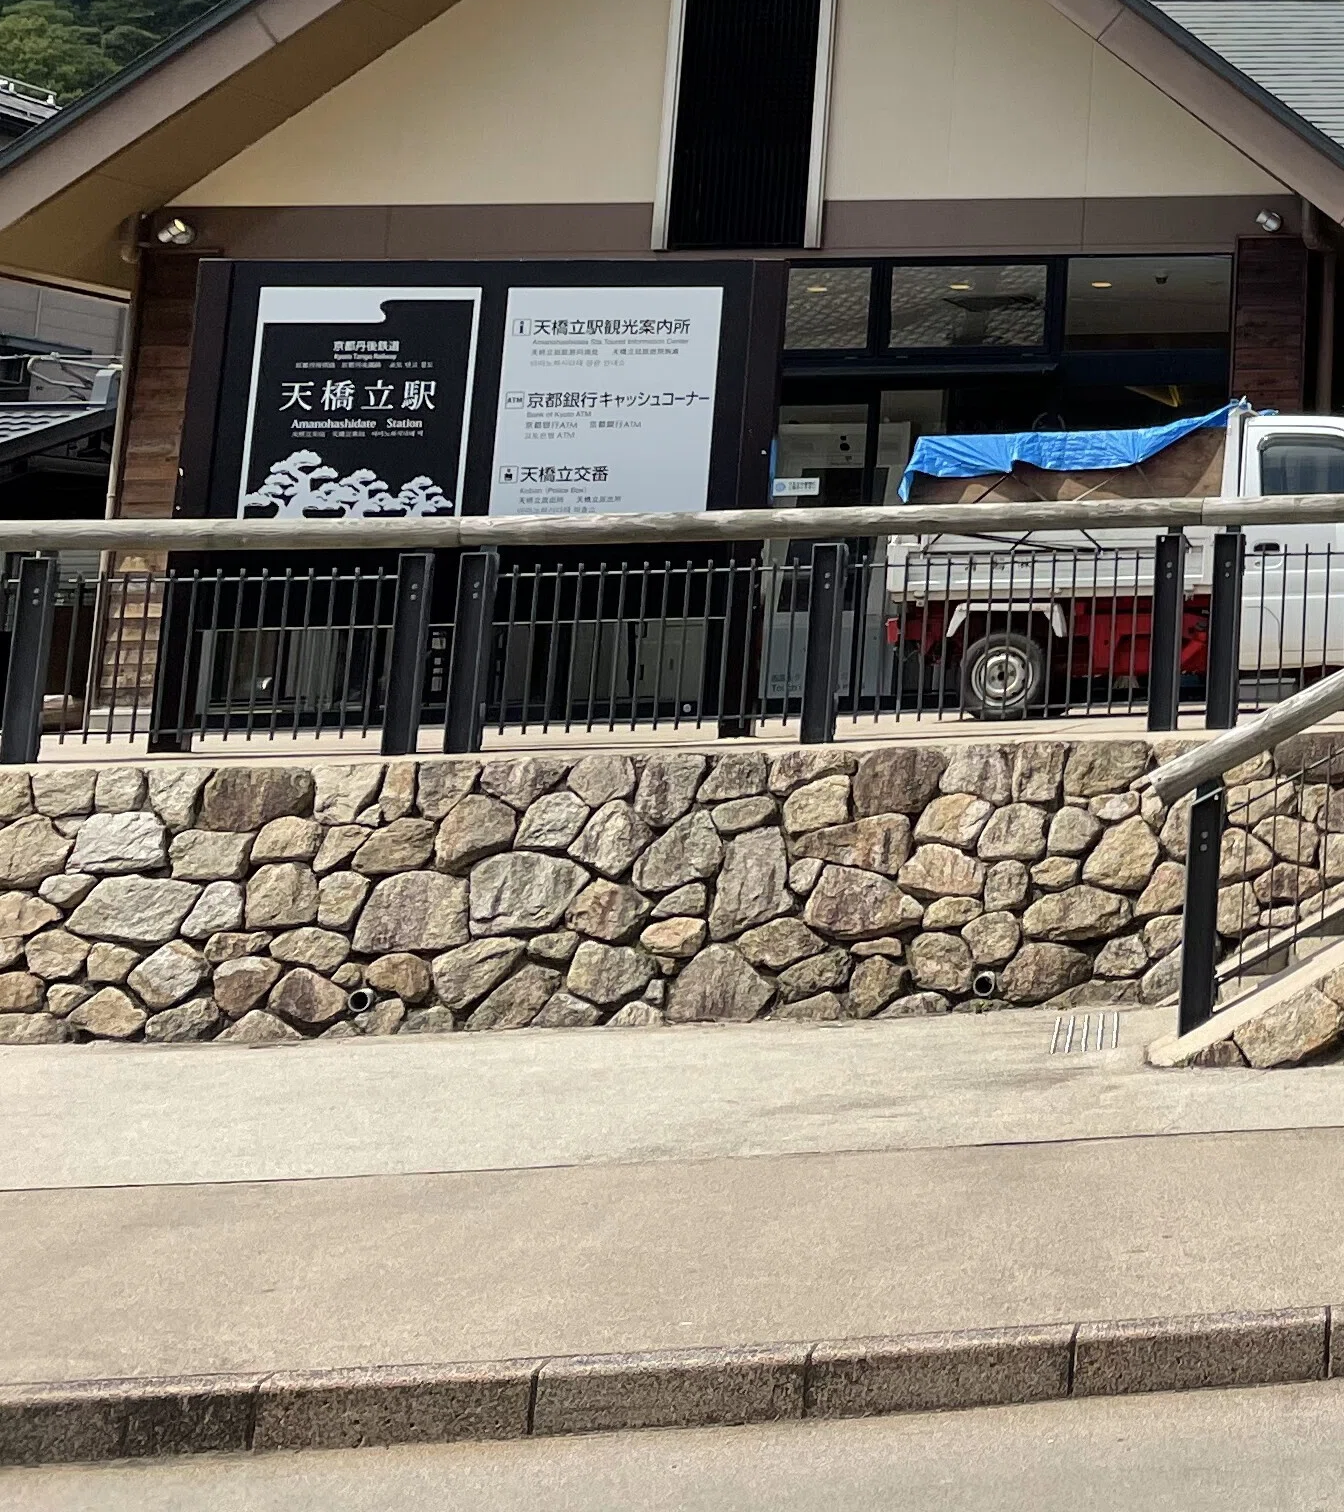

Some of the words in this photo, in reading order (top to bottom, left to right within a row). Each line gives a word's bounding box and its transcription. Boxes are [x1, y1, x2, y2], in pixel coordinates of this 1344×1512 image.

[533, 319, 691, 335] 天橋立駅観光案内所
[279, 380, 437, 411] 天橋立駅
[527, 391, 710, 408] 京都銀行キャッシュコーナー
[291, 419, 376, 428] Amanohashidate
[386, 418, 423, 428] Station
[520, 466, 609, 482] 天橋立交番
